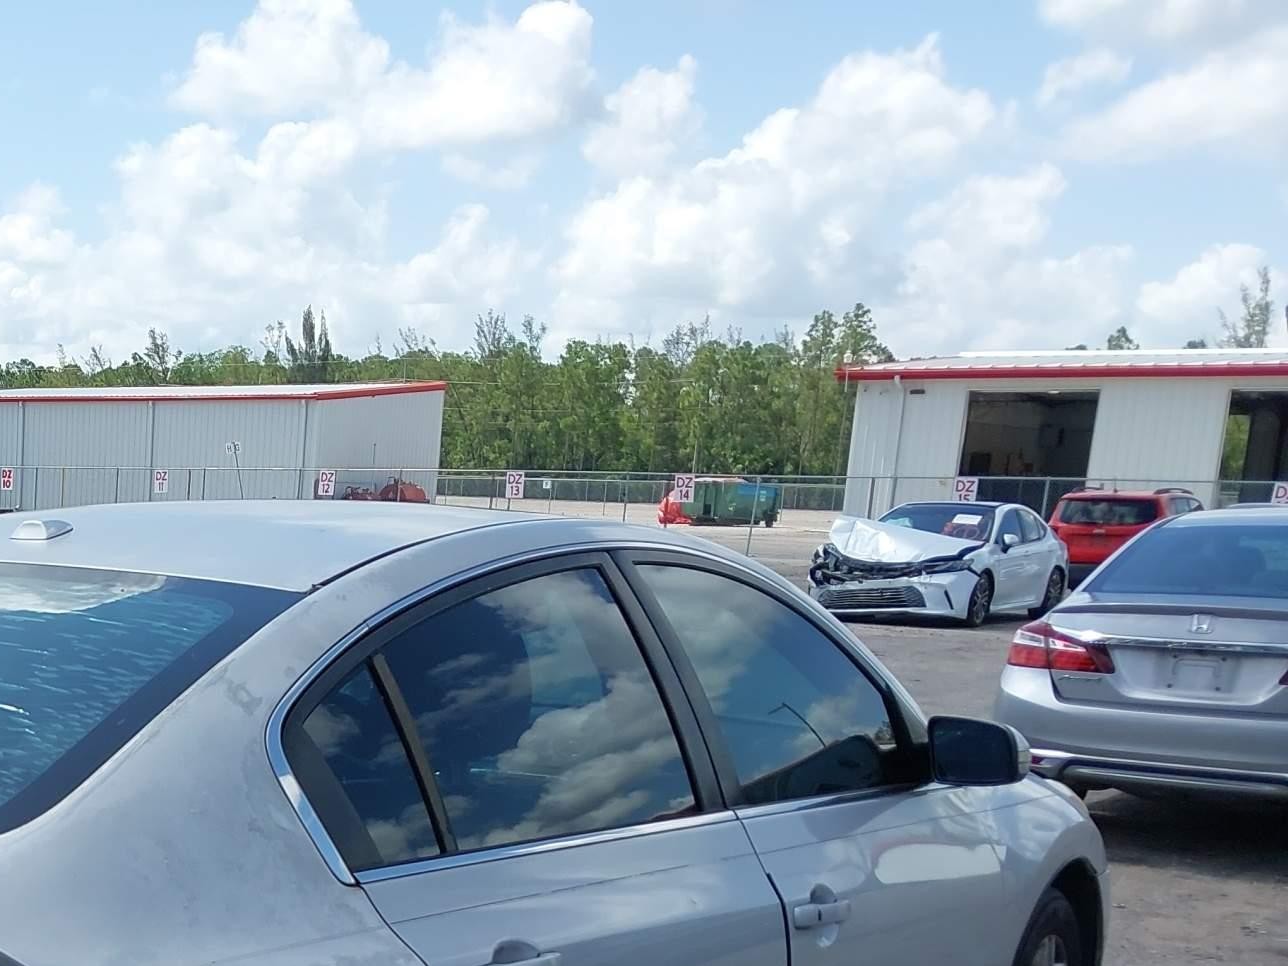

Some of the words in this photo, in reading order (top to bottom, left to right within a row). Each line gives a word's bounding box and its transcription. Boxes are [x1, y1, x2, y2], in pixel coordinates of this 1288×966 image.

[2, 469, 12, 479] DZ
[155, 471, 168, 481] DZ
[321, 471, 334, 483] DZ
[508, 473, 522, 485] DZ
[2, 479, 11, 489] 10
[158, 481, 164, 492] 11
[676, 476, 693, 489] DZ
[955, 480, 976, 493] DZ
[321, 483, 330, 494] 12
[510, 485, 520, 496] 13
[1275, 486, 1288, 499] D
[679, 489, 689, 501] 14
[958, 494, 970, 502] 15
